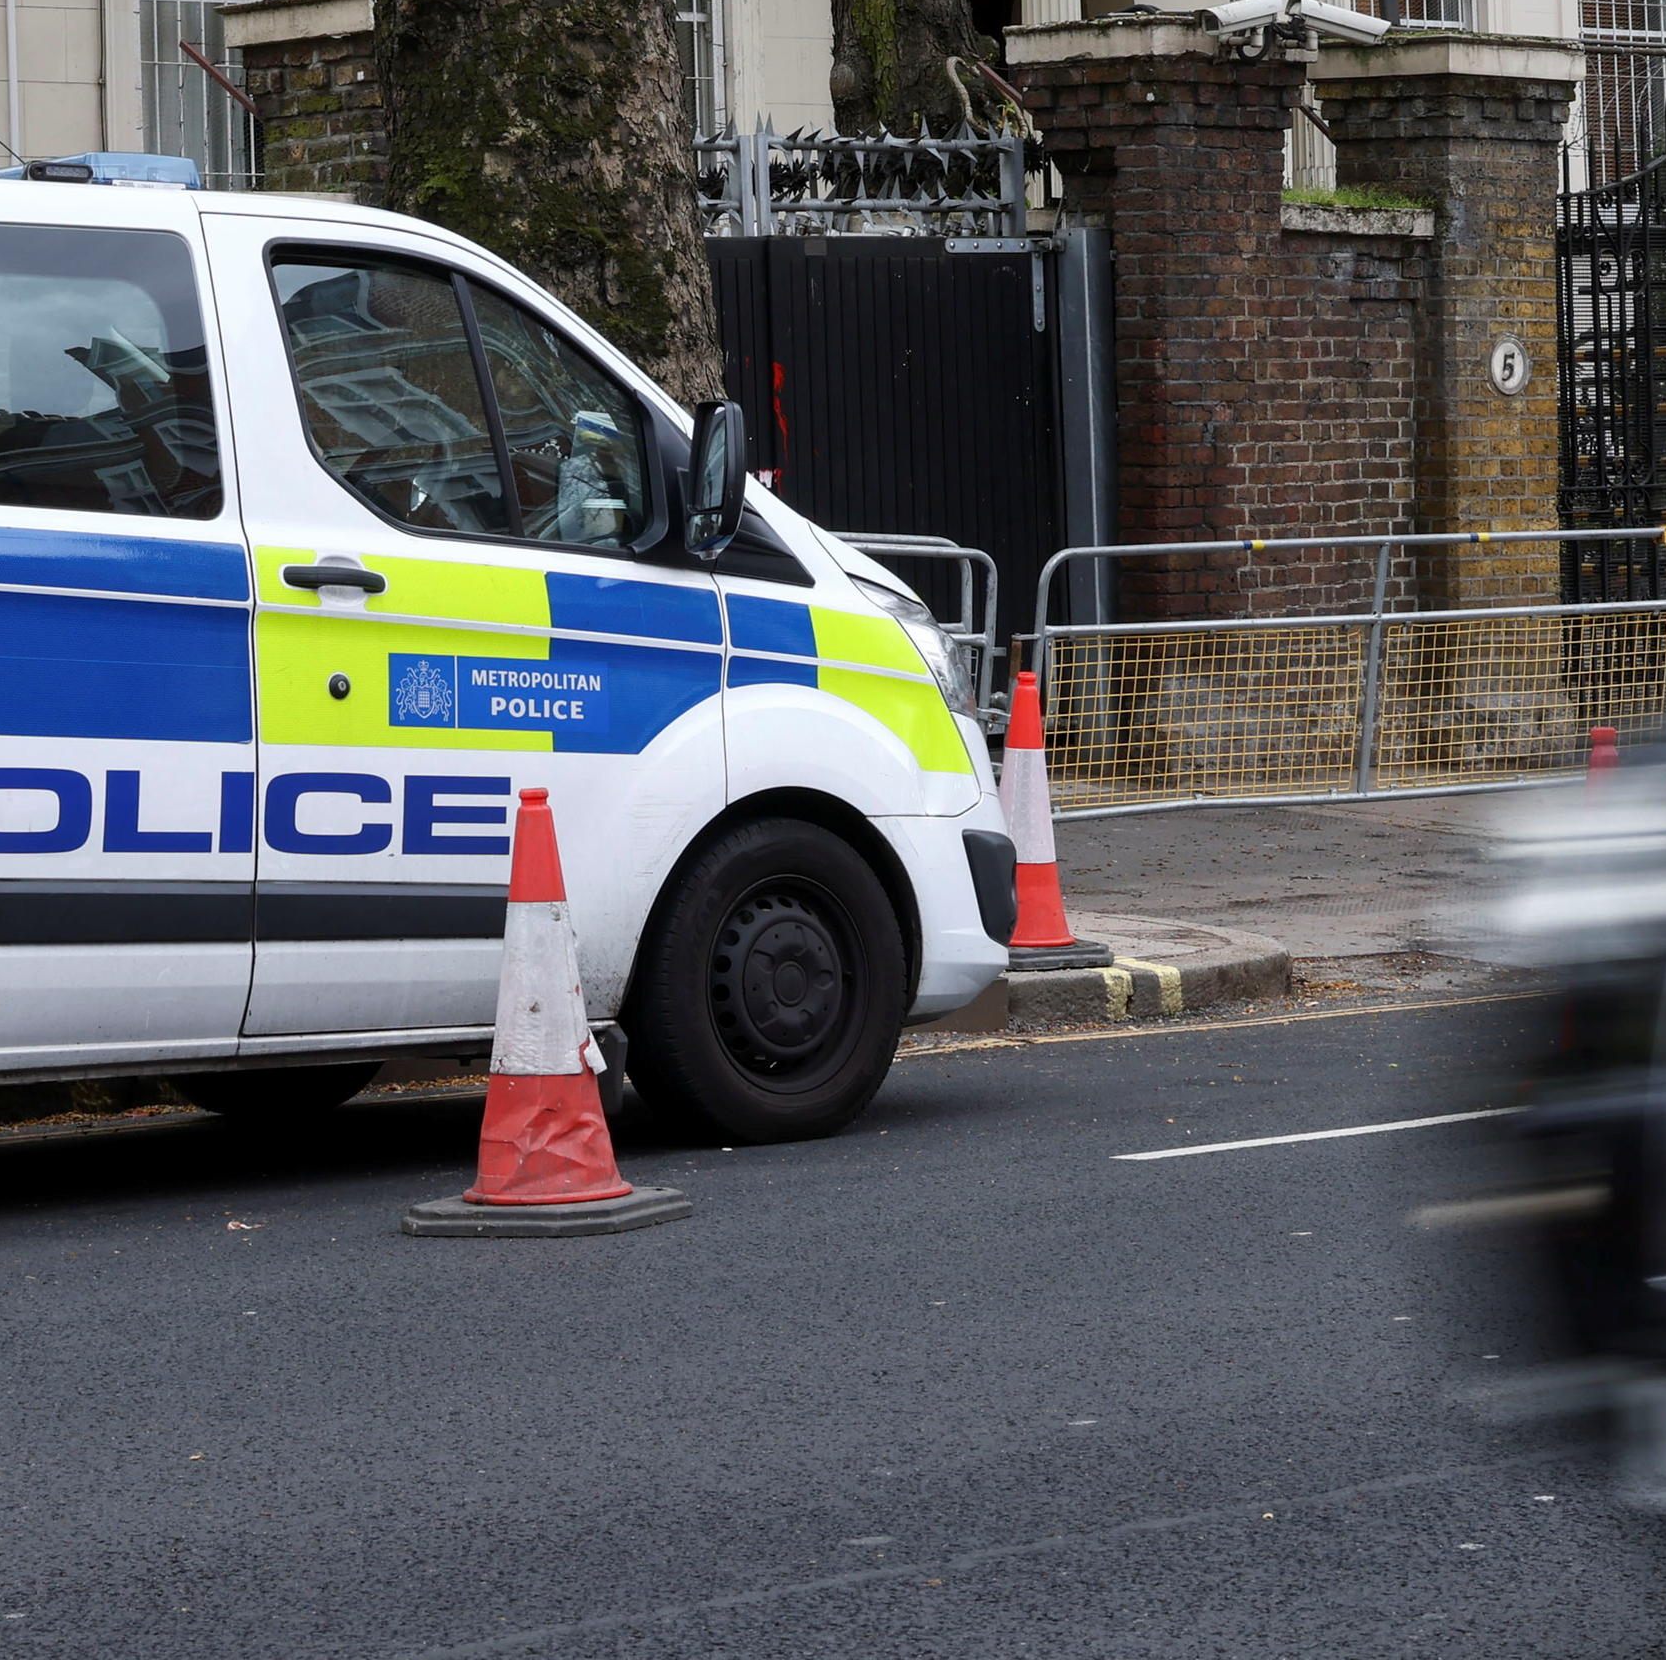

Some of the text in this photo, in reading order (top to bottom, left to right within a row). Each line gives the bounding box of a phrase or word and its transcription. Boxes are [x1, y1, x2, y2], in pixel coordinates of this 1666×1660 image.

[1502, 352, 1515, 381] 5
[471, 669, 601, 691] METROPOLITAN
[491, 697, 585, 720] POLICE
